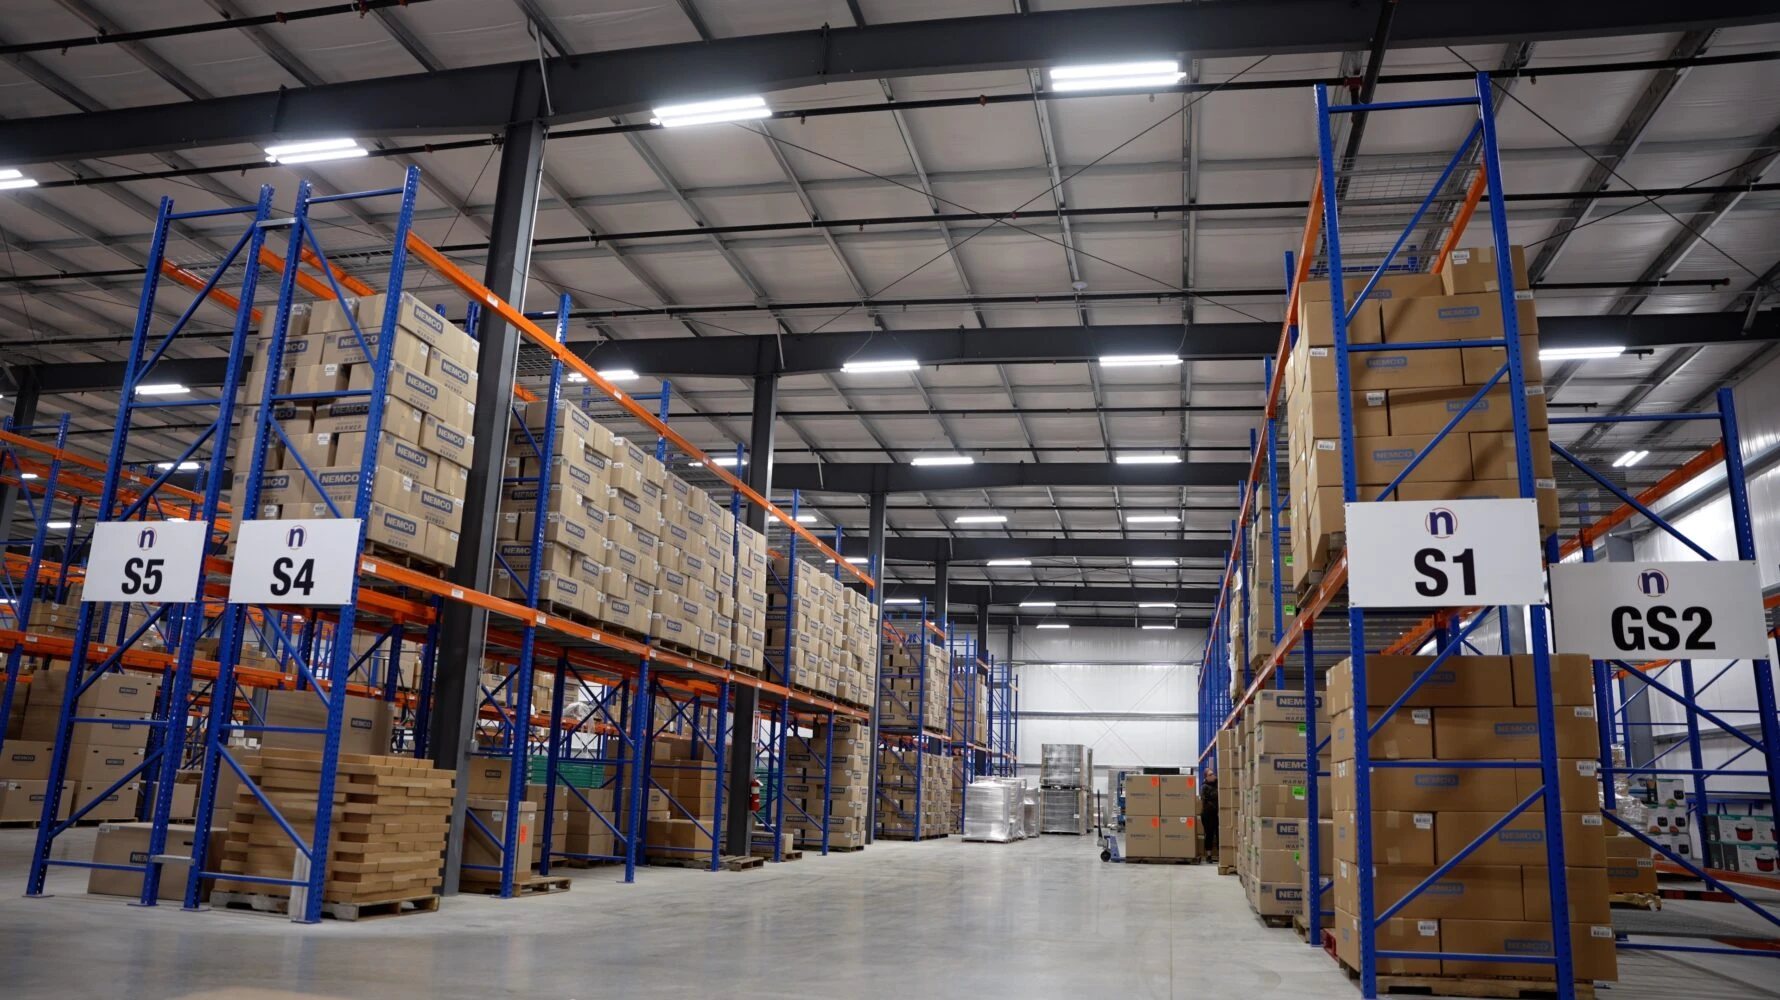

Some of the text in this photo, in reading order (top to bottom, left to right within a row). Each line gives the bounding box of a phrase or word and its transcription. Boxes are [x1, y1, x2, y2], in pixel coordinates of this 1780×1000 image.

[415, 307, 443, 331] NEMCO
[1440, 308, 1478, 318] NEMCO
[443, 362, 468, 382] NEMCO
[1368, 358, 1405, 367] NEMCO
[407, 375, 437, 397] NEMCO
[438, 426, 463, 446] NEMCO
[397, 446, 426, 466] NEMCO
[1376, 450, 1414, 459] NEMCO
[321, 474, 359, 483] NEMCO
[423, 493, 452, 512] NEMCO
[386, 515, 415, 533] NEMCO
[1429, 511, 1454, 535] n
[140, 529, 155, 548] n
[288, 528, 304, 547] n
[122, 558, 164, 594] S5
[271, 558, 314, 596] S4
[1415, 548, 1476, 596] S1
[1641, 571, 1665, 594] n
[1611, 606, 1716, 651] GS2
[1277, 761, 1307, 769] NEMC
[1501, 831, 1541, 840] NEMCO
[1279, 890, 1302, 899] NEM
